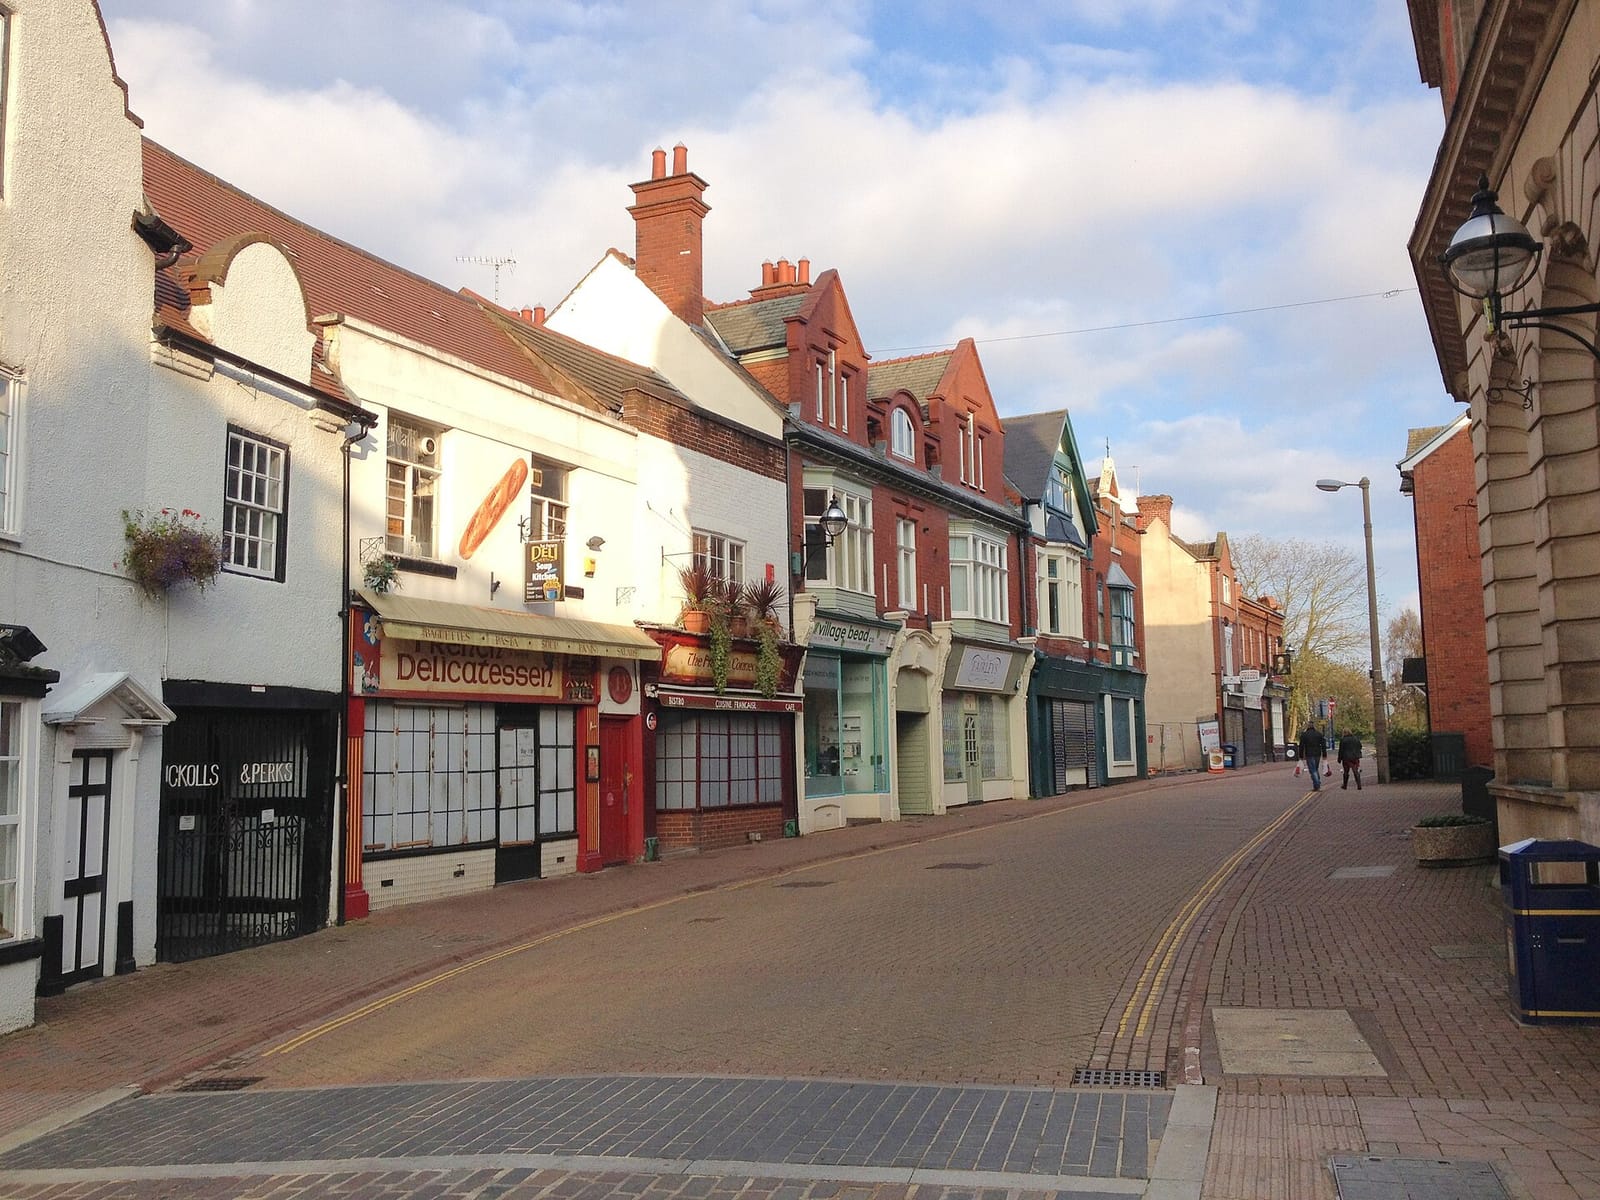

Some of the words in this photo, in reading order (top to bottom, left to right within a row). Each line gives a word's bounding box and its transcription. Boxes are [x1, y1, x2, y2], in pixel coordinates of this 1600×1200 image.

[531, 544, 558, 561] DELI
[536, 563, 553, 571] Soup
[819, 622, 847, 642] village
[847, 625, 871, 642] bead
[495, 635, 519, 647] PASTA
[541, 639, 558, 650] SOUP
[687, 652, 702, 667] The
[397, 653, 553, 688] Delicatessen
[668, 696, 685, 706] BISTRO
[715, 700, 732, 708] CUISINE
